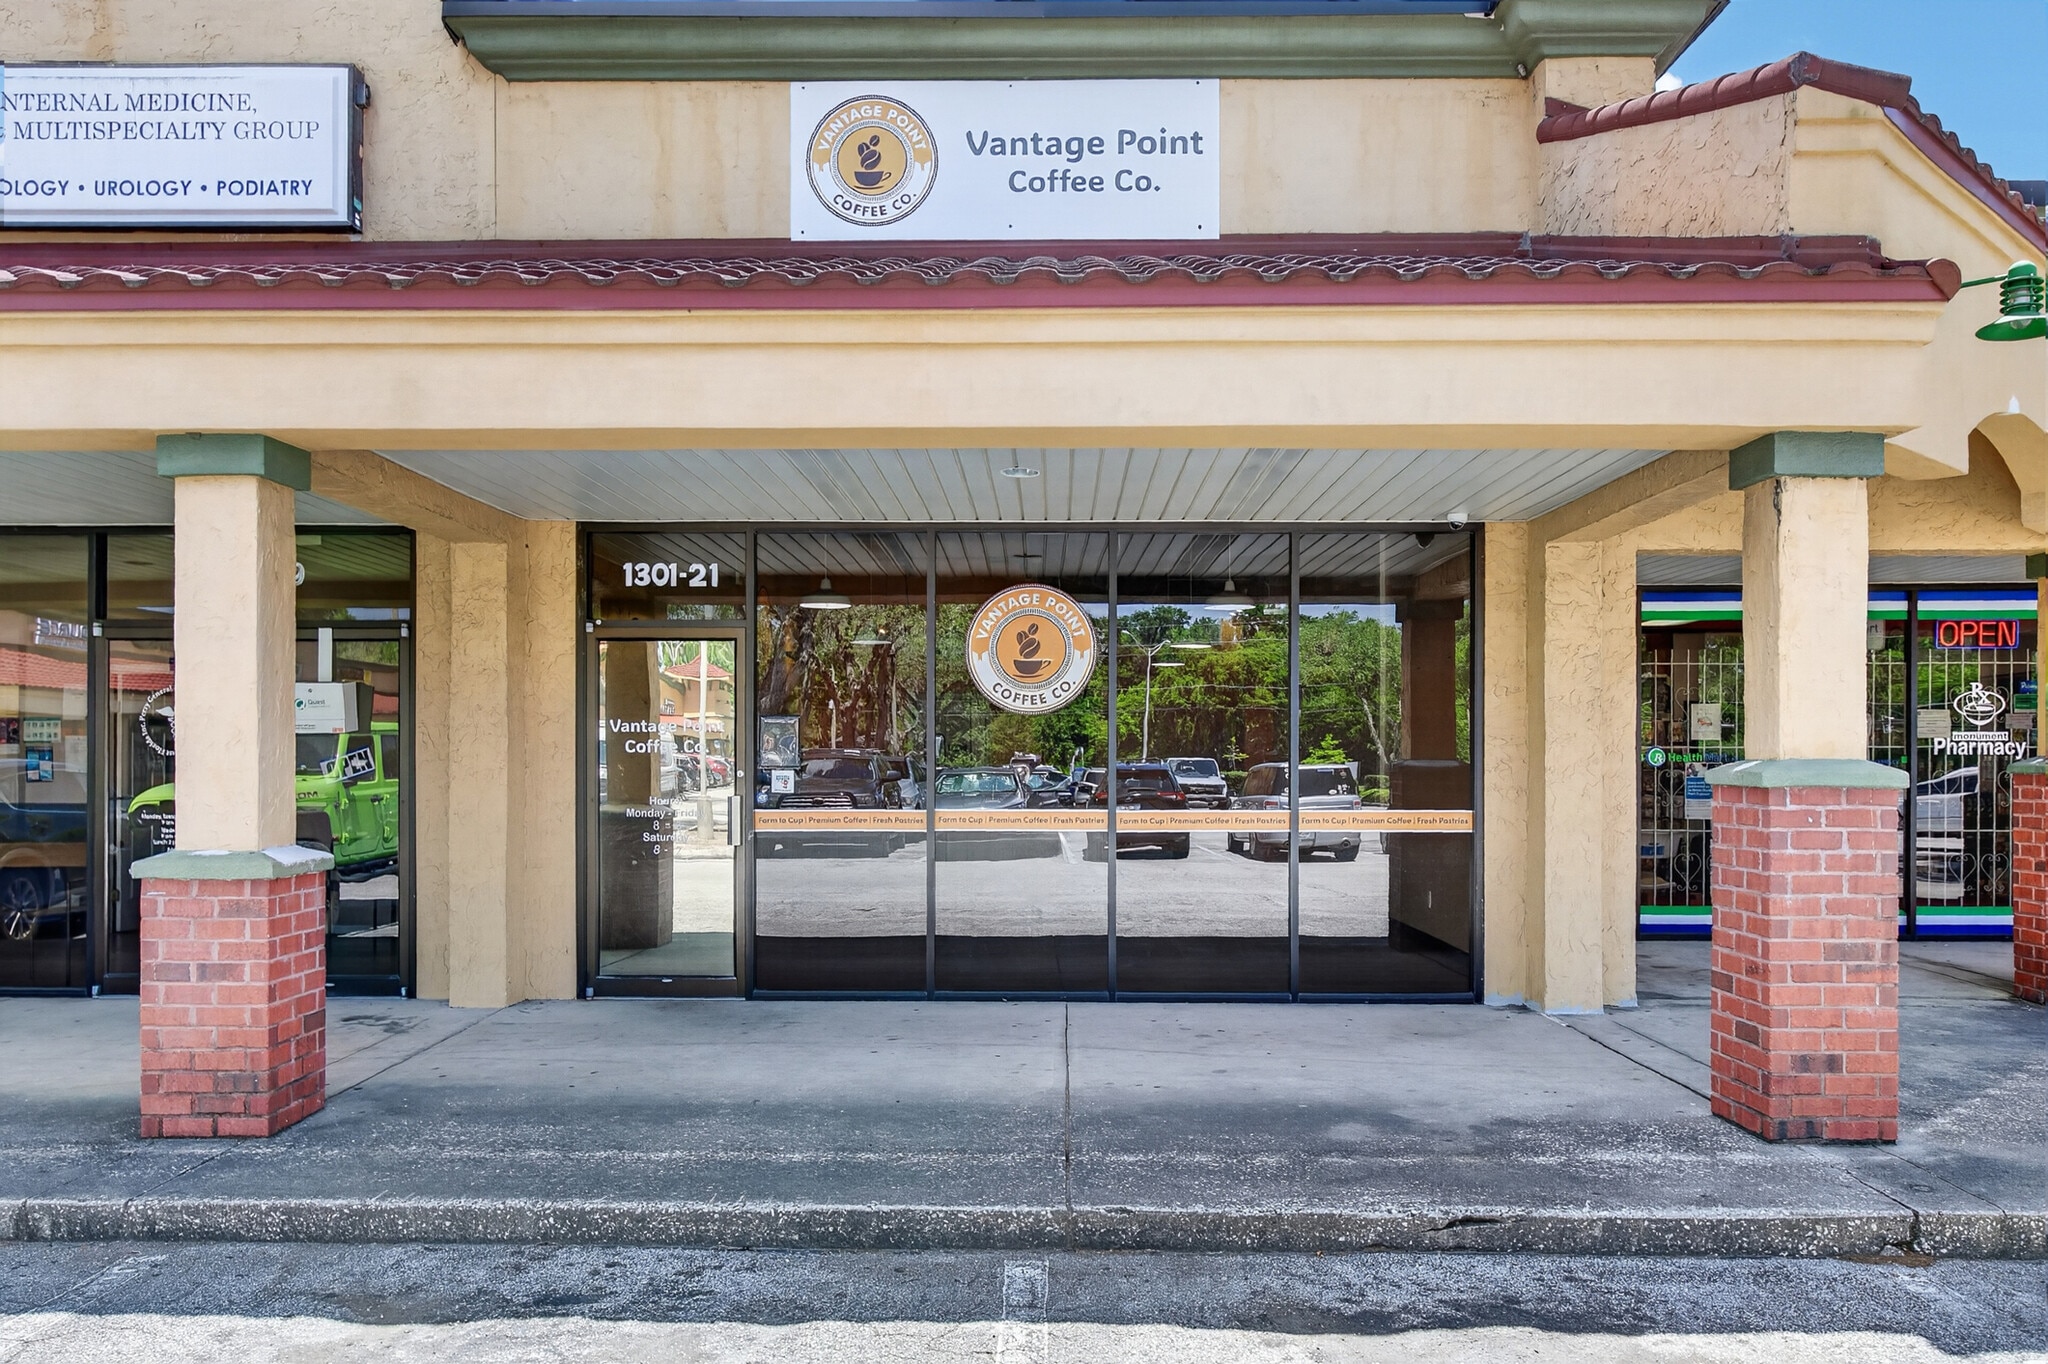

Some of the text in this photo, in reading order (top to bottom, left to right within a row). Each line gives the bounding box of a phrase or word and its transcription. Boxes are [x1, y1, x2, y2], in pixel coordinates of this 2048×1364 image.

[0, 91, 257, 114] NTERNAL MEDICINE,
[13, 120, 225, 140] MULTISPECIALTY
[234, 120, 320, 140] GROUP
[817, 105, 927, 150] VANTAGE POINT
[966, 127, 1204, 163] Vantage Point
[0, 179, 313, 197] OLOGY UROLOGY PODIATRY
[1008, 169, 1161, 193] Coffee Co.
[833, 193, 917, 217] COFFEE CO.
[622, 562, 719, 588] 1301-21
[976, 594, 1085, 638] VANTAGE POINT
[1938, 621, 2016, 646] OPEN
[992, 680, 1077, 705] COFFEE CO.
[609, 718, 677, 736] Vantage
[1953, 732, 2008, 740] monument
[1933, 737, 2027, 759] Pharmacy
[1668, 752, 1703, 763] Health
[626, 808, 666, 819] Monday
[759, 816, 924, 825] Farm to Cup Premium Coffee Fresh Pastries
[938, 816, 1104, 825] Farm to Cup Premium Coffee Fresh Pastries
[1119, 817, 1286, 826] Farm to Cup Premium Coffee Fresh Pastries
[1301, 817, 1468, 826] Farm to Cup Premium Coffee Fresh Pastries
[653, 820, 660, 830] 8
[643, 832, 689, 844] Saturday
[653, 844, 660, 855] 8
